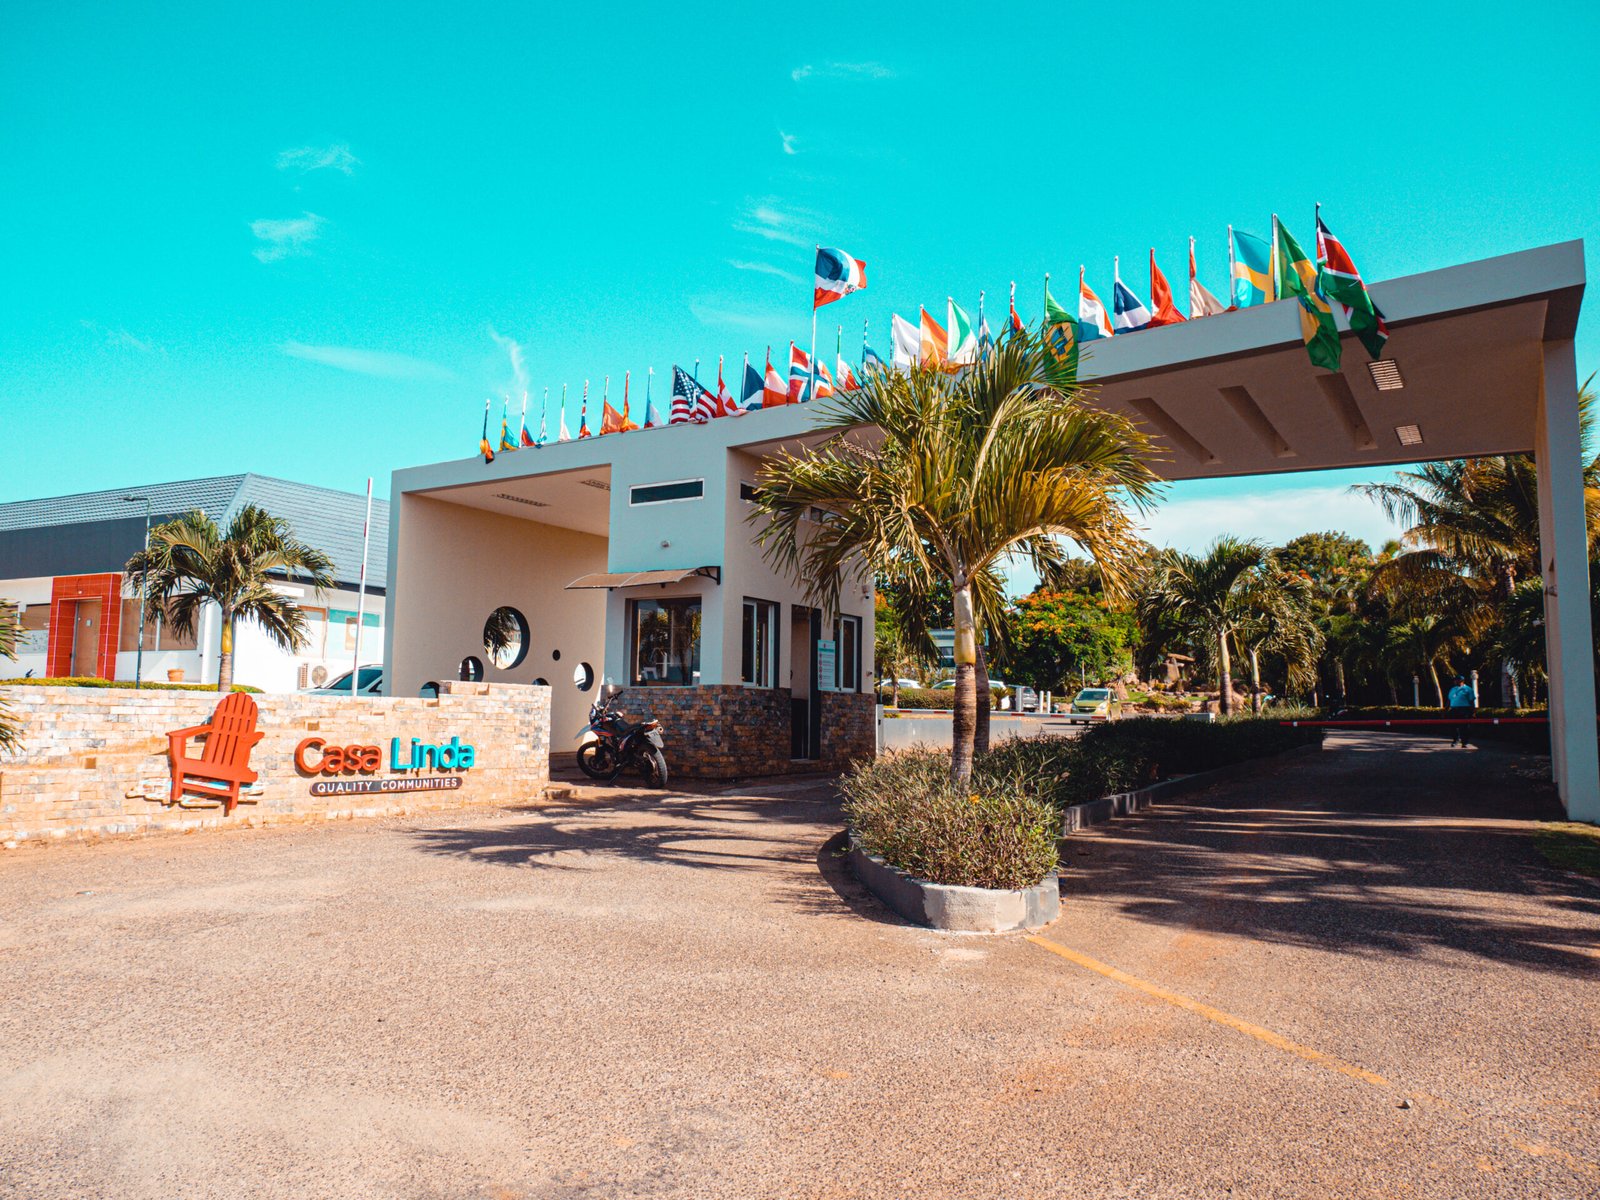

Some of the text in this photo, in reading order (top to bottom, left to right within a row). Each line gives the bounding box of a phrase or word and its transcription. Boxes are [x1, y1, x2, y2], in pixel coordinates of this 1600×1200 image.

[295, 736, 475, 773] Casa Linda
[317, 778, 458, 793] QUALITY COMMUNITIES
